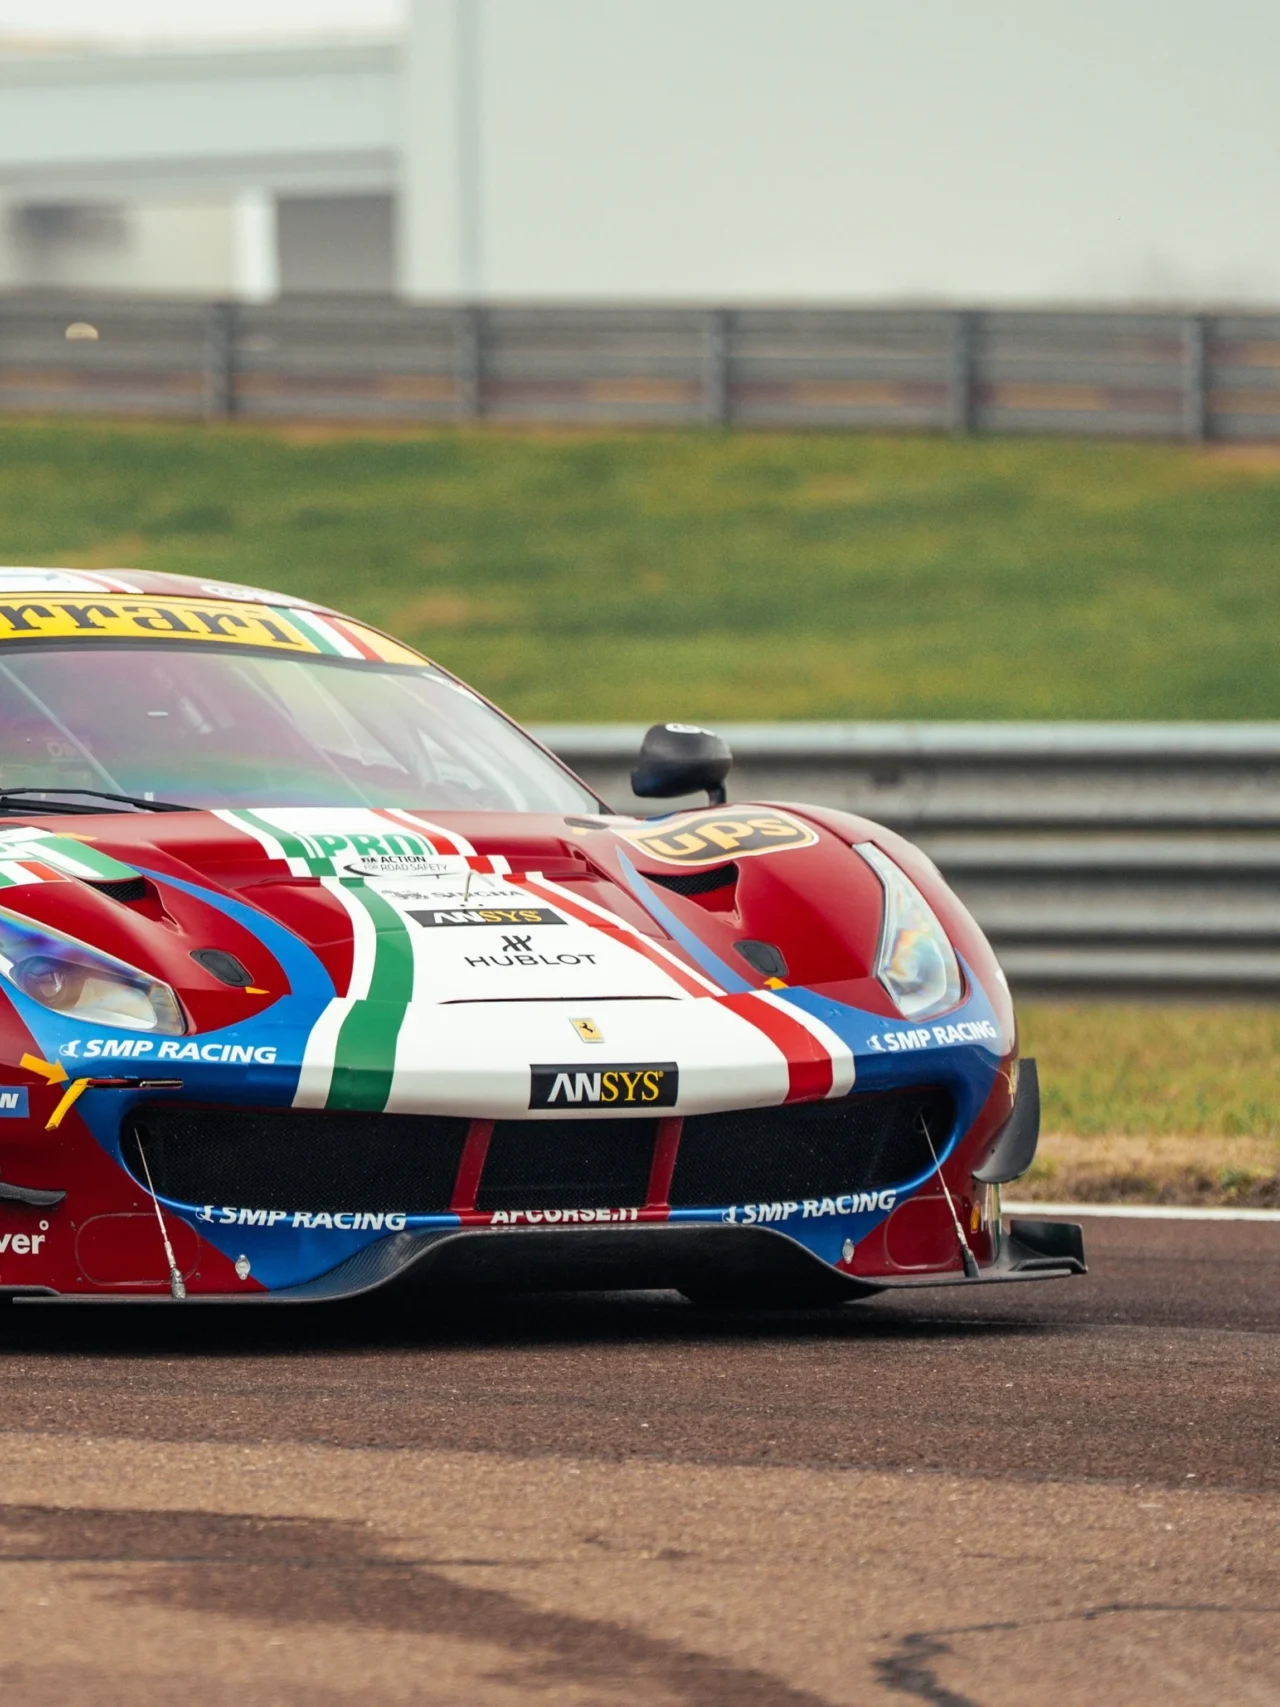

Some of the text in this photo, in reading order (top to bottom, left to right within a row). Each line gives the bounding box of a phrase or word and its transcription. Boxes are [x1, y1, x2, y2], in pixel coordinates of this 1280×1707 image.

[642, 818, 799, 856] ups
[380, 855, 427, 863] ACTION
[381, 863, 409, 872] ROAD
[410, 863, 448, 871] SAFETY
[433, 910, 542, 925] ANSYS
[464, 954, 598, 967] HUBLOT
[884, 1020, 997, 1052] SMP RACING
[83, 1039, 277, 1064] SMP RACING
[547, 1070, 661, 1103] ANSYS
[219, 1206, 407, 1231] SMP RACING
[742, 1189, 897, 1224] SMP RACING
